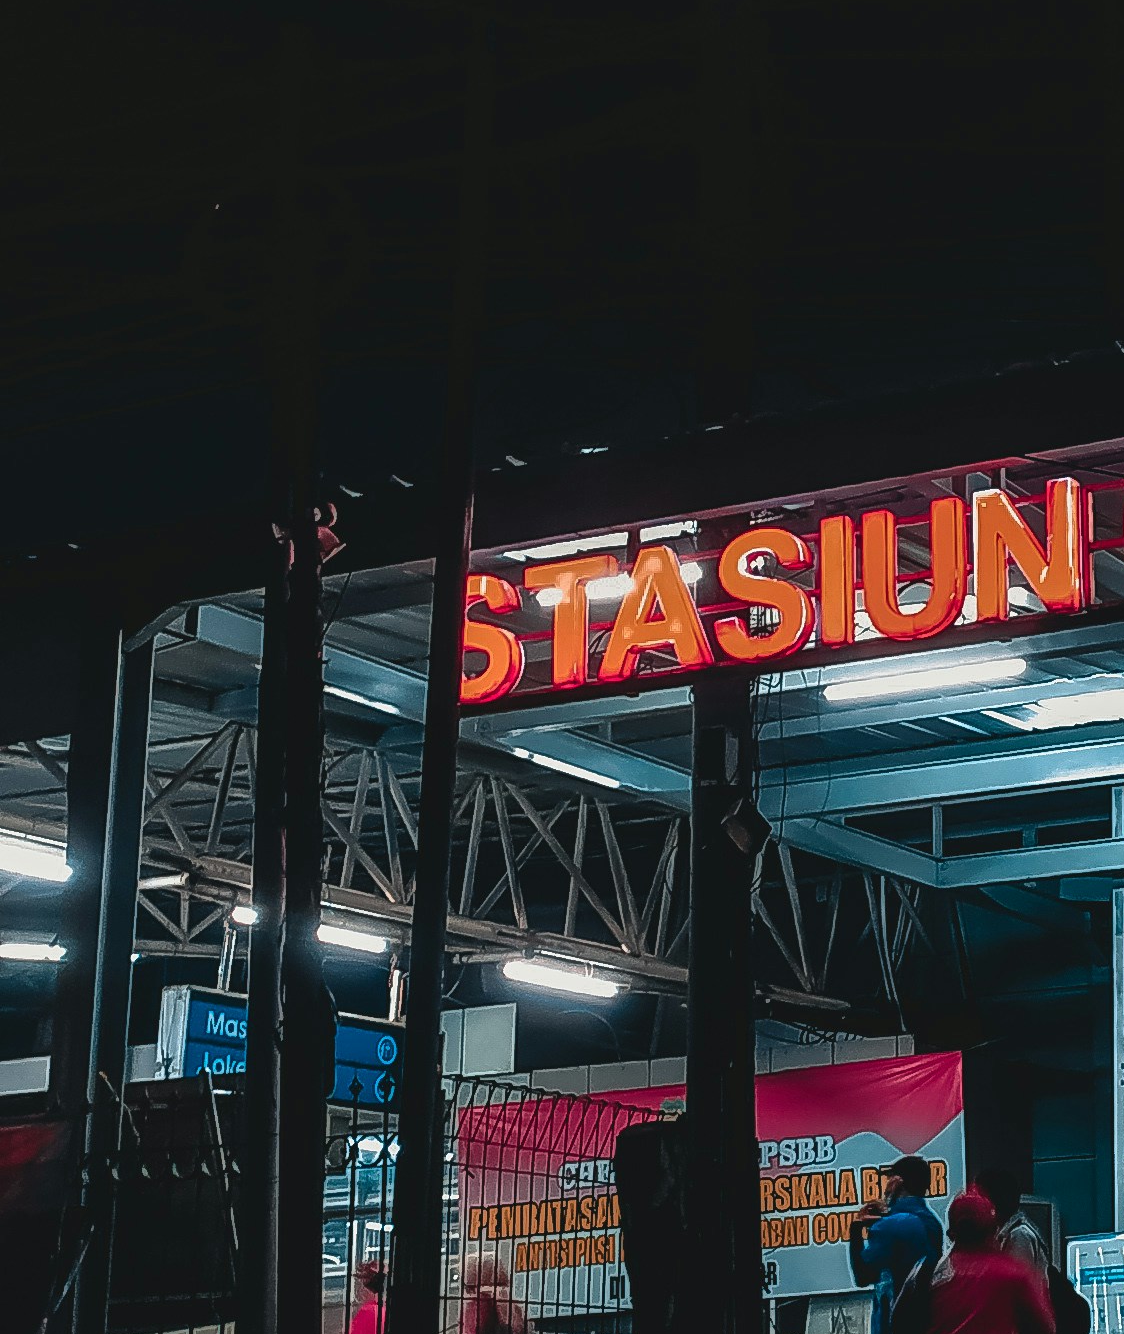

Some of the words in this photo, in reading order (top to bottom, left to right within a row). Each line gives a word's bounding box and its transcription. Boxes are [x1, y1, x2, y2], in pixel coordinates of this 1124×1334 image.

[459, 478, 1095, 704] STASIUN
[206, 1010, 248, 1040] Mas
[203, 1051, 247, 1075] Loke
[758, 1135, 836, 1168] PSBB
[760, 1167, 859, 1212] RSKALA
[761, 1215, 809, 1248] ABAH
